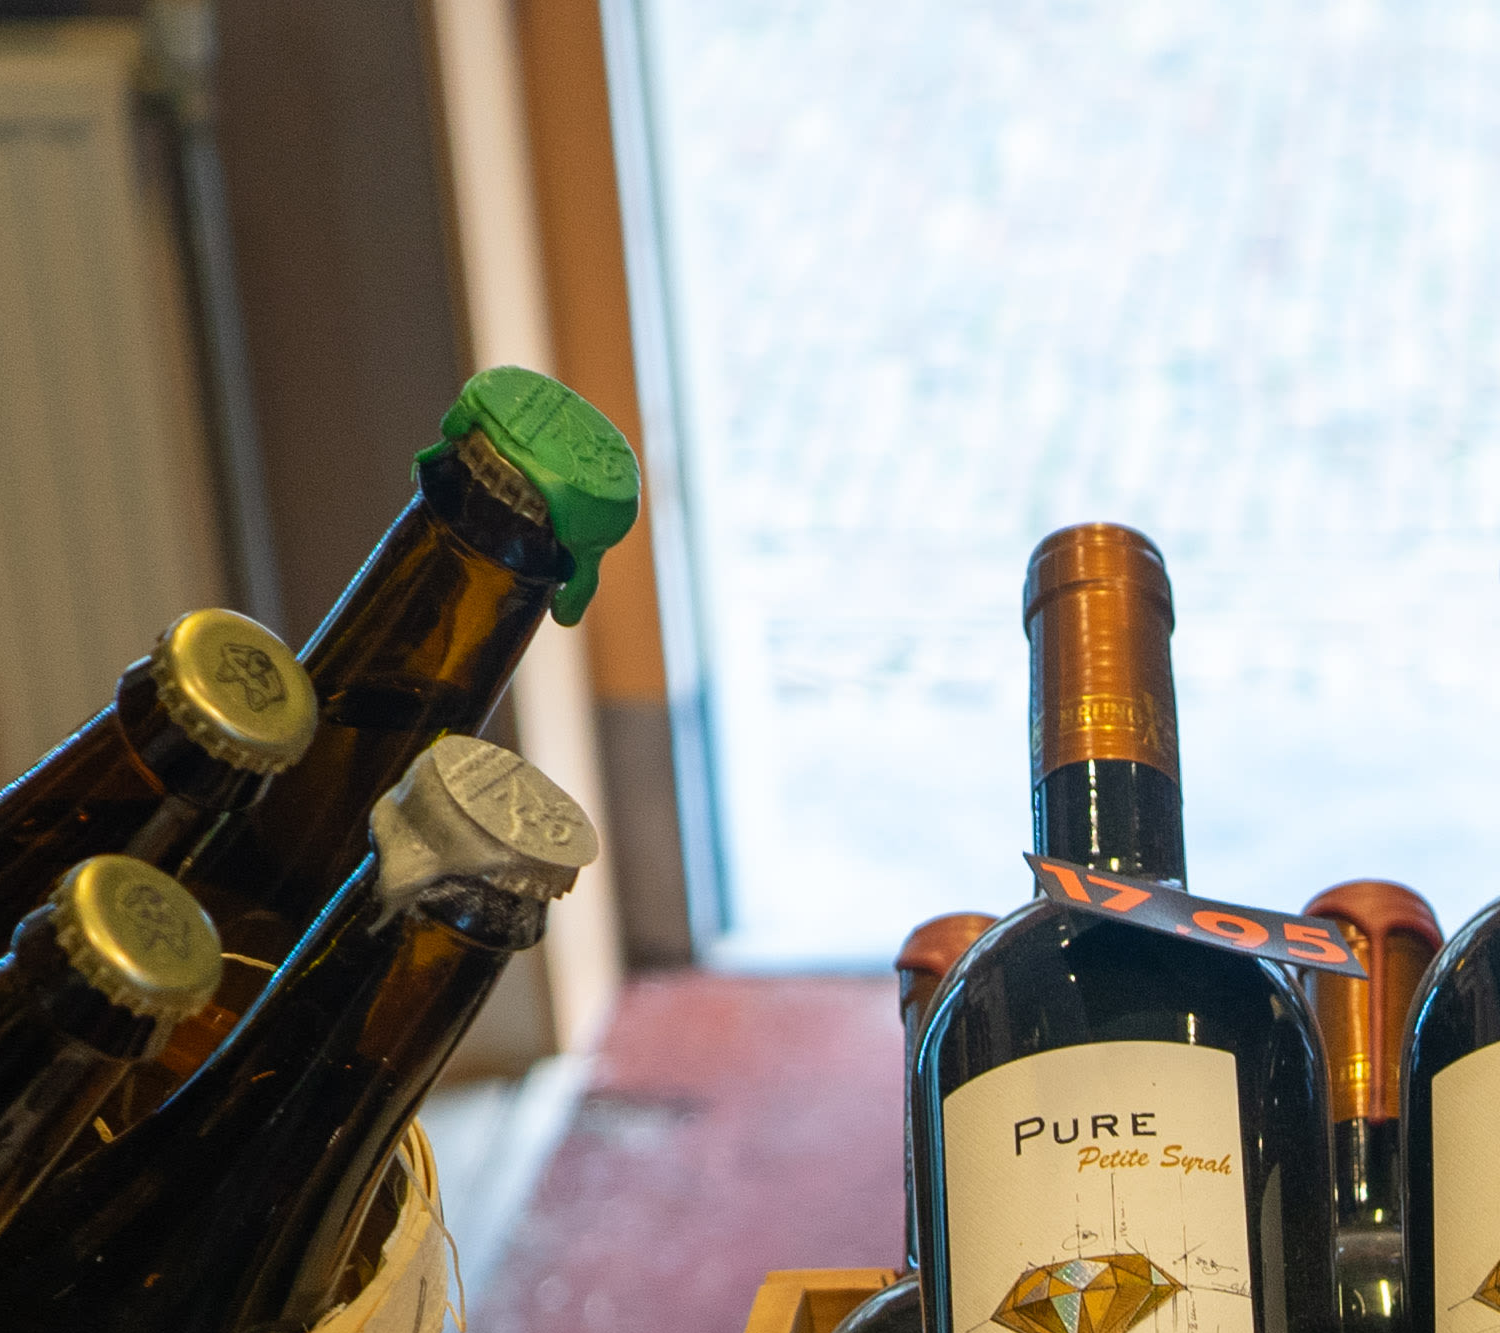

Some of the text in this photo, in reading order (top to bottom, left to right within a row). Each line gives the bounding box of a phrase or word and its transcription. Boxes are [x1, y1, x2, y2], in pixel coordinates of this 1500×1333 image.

[1014, 1112, 1157, 1156] PURE
[1077, 1145, 1232, 1175] Petite Syrah
